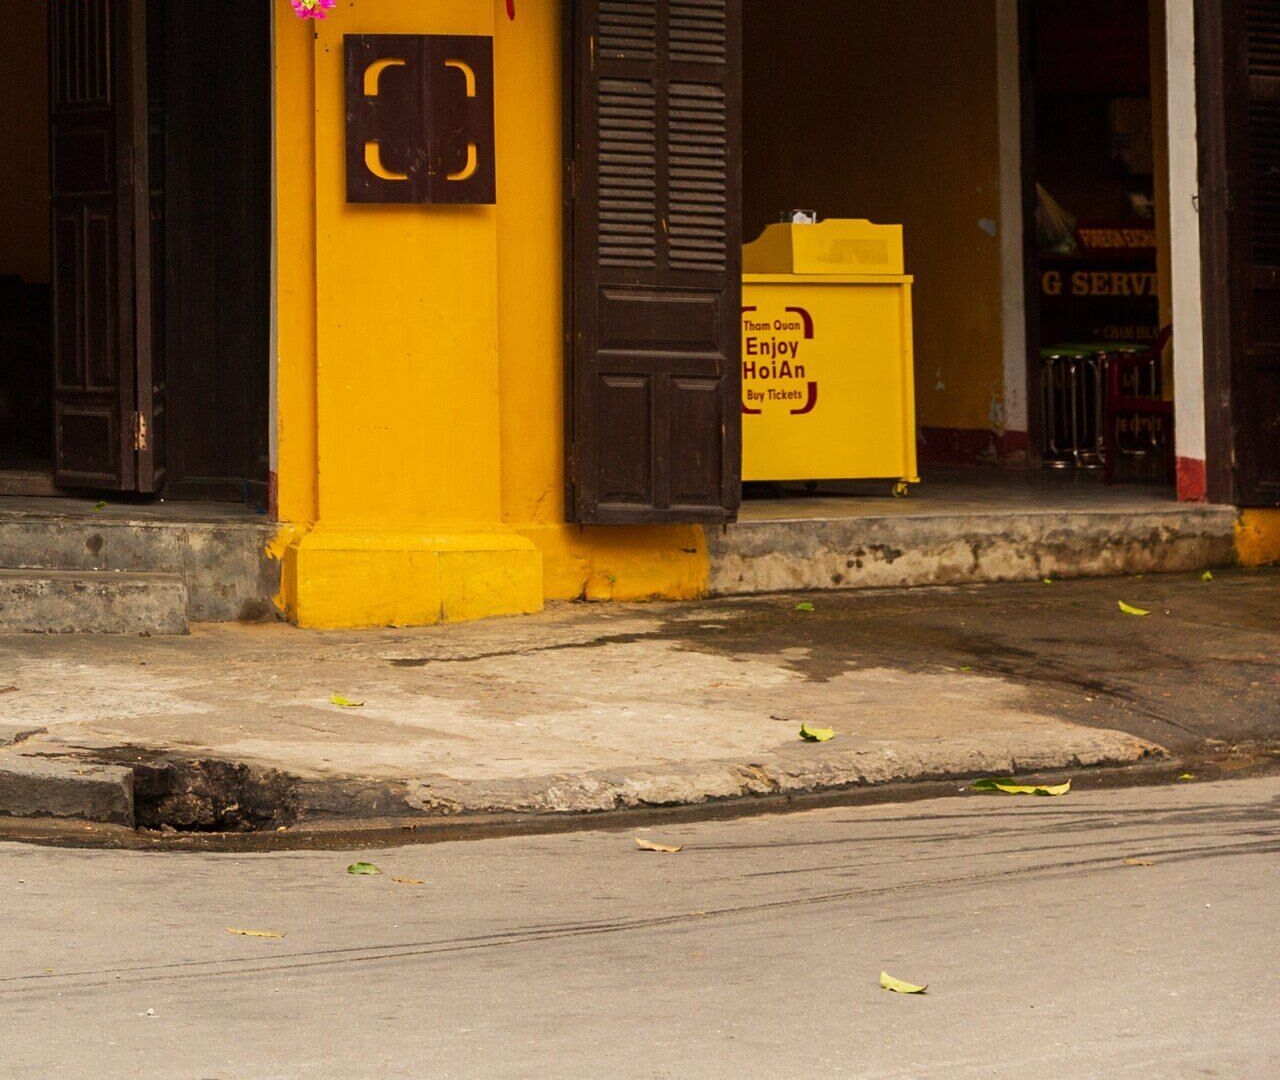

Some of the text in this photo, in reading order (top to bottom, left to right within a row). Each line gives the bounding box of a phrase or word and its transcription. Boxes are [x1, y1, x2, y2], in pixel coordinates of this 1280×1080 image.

[1042, 270, 1062, 296] G
[744, 320, 800, 331] Tham Quan
[746, 337, 799, 359] Enjoy
[743, 361, 805, 379] HoiAn
[747, 389, 802, 402] Buy Tickets
